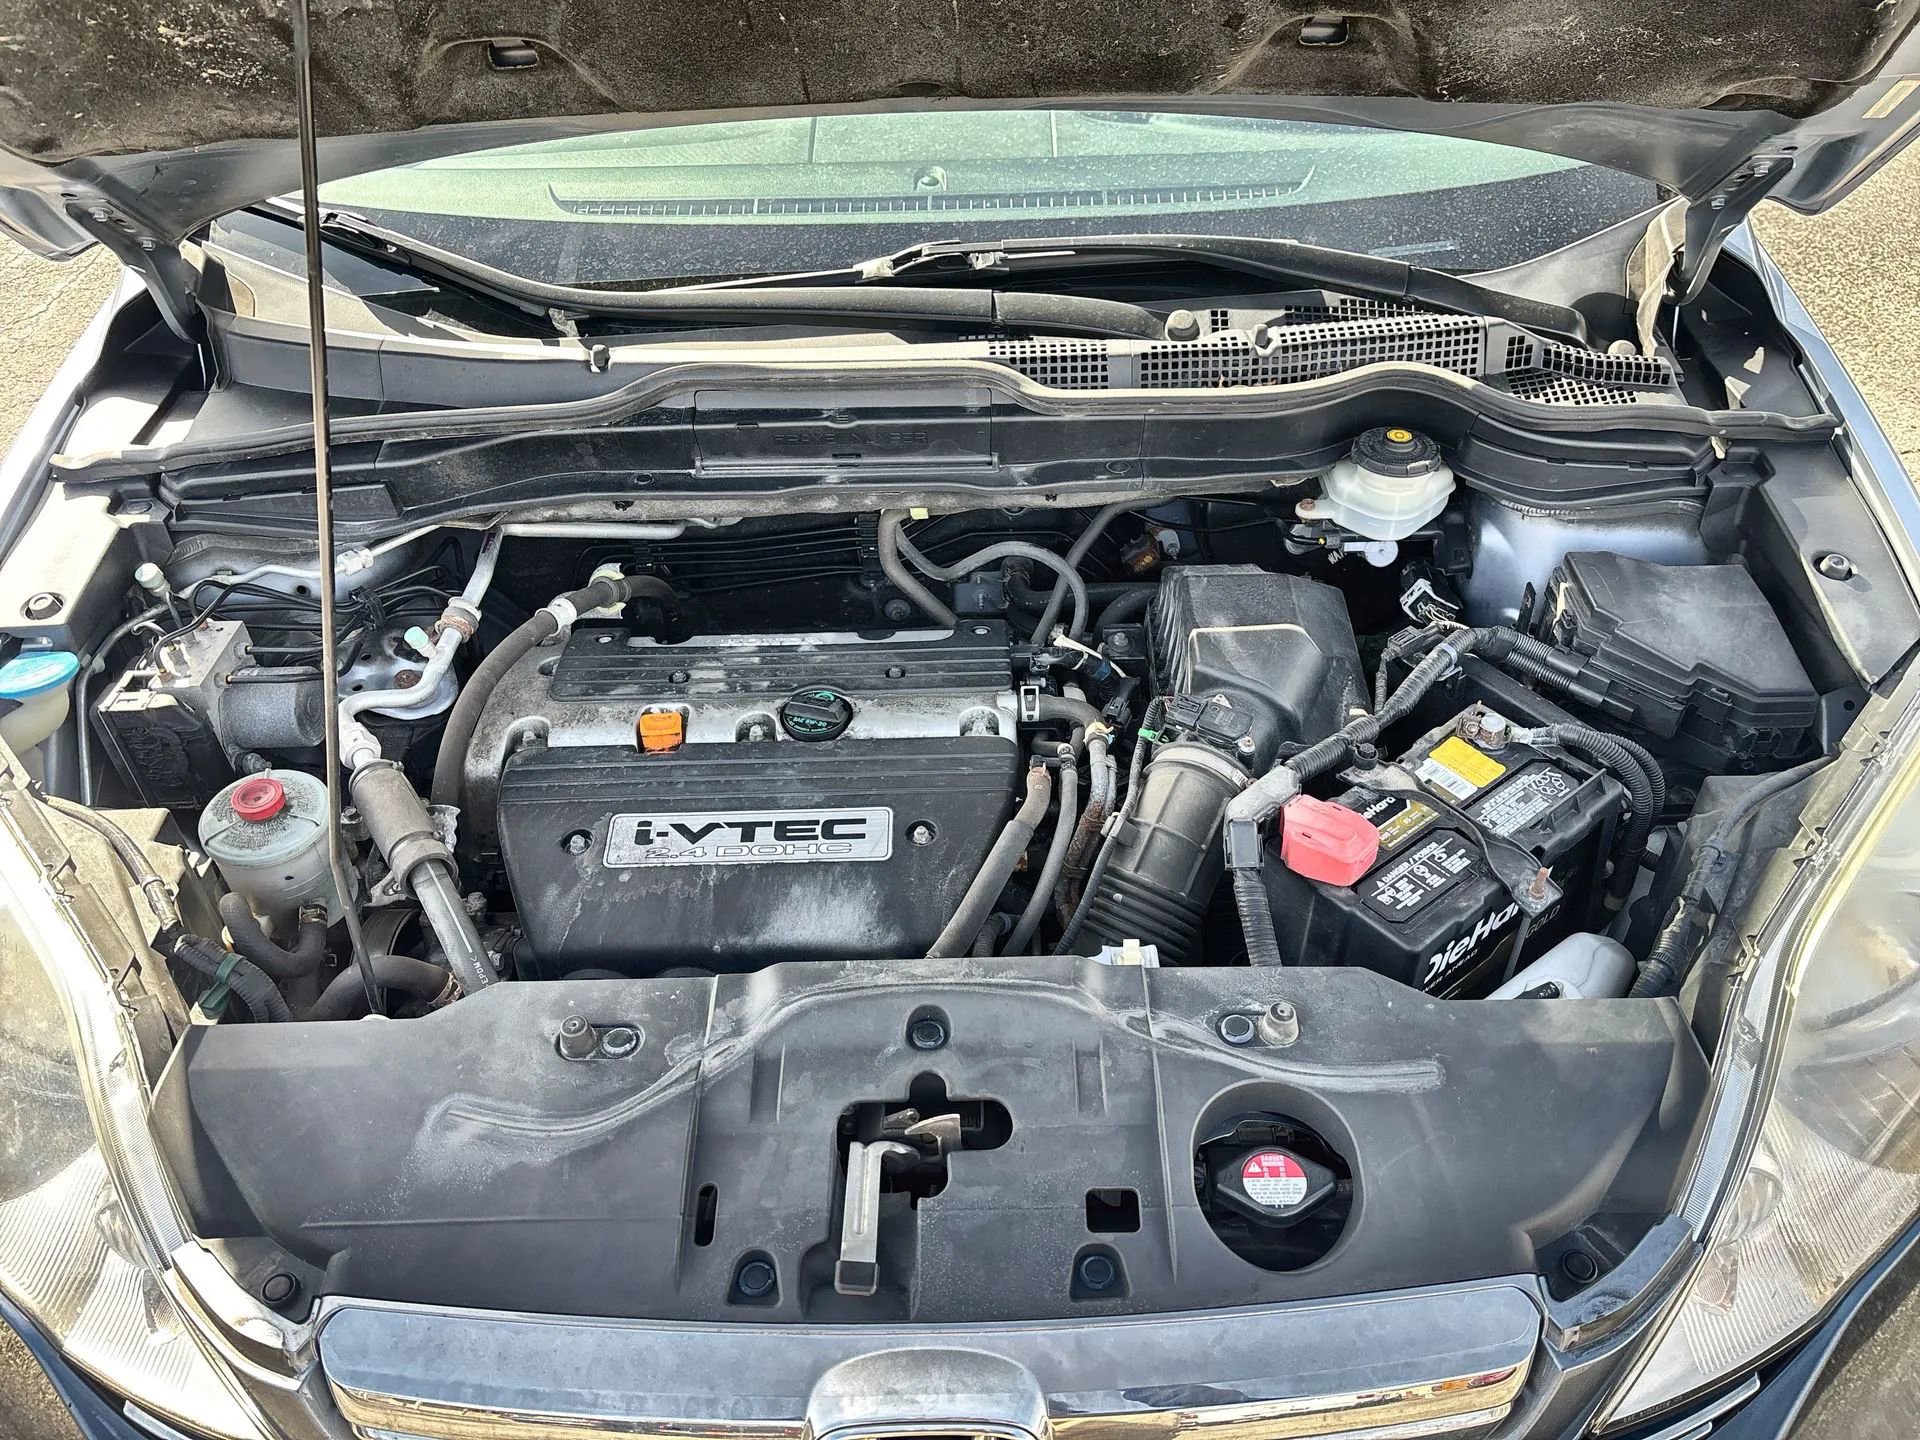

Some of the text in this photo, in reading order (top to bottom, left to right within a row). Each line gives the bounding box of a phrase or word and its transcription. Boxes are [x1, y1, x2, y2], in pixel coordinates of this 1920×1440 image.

[774, 432, 928, 446] FRAME NUMBER
[633, 818, 867, 846] i-VTEC
[645, 842, 852, 859] 2.4 DOHC
[1381, 861, 1411, 883] DANGER
[1412, 841, 1440, 862] POISON
[1525, 904, 1561, 939] GOLD
[1444, 948, 1479, 978] AHEAD
